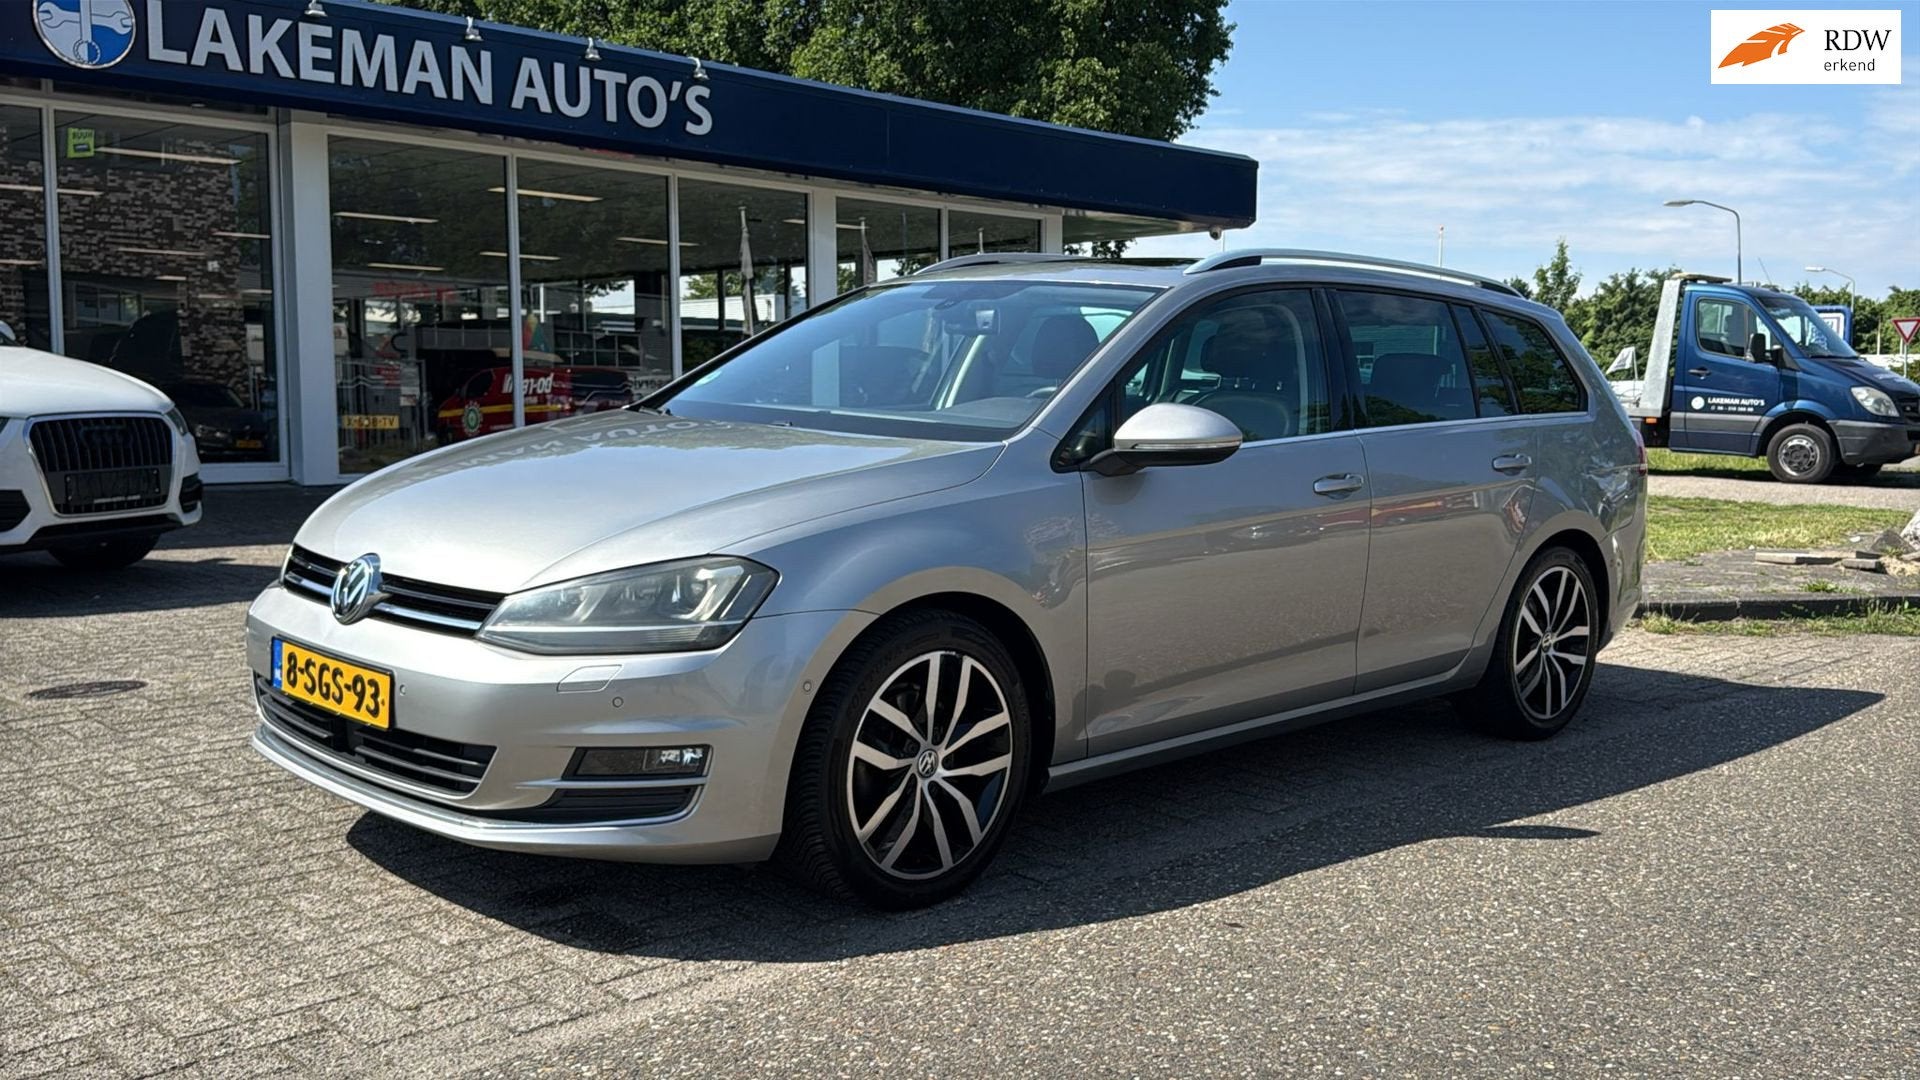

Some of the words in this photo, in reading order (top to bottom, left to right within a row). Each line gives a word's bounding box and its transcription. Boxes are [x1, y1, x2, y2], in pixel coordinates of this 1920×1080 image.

[147, 0, 494, 106] LAKEMAN
[511, 57, 713, 136] AUTO'S
[1707, 397, 1740, 405] LAKEMAN
[1740, 398, 1766, 407] AUTO'S
[286, 651, 381, 718] 8-SGS-93
